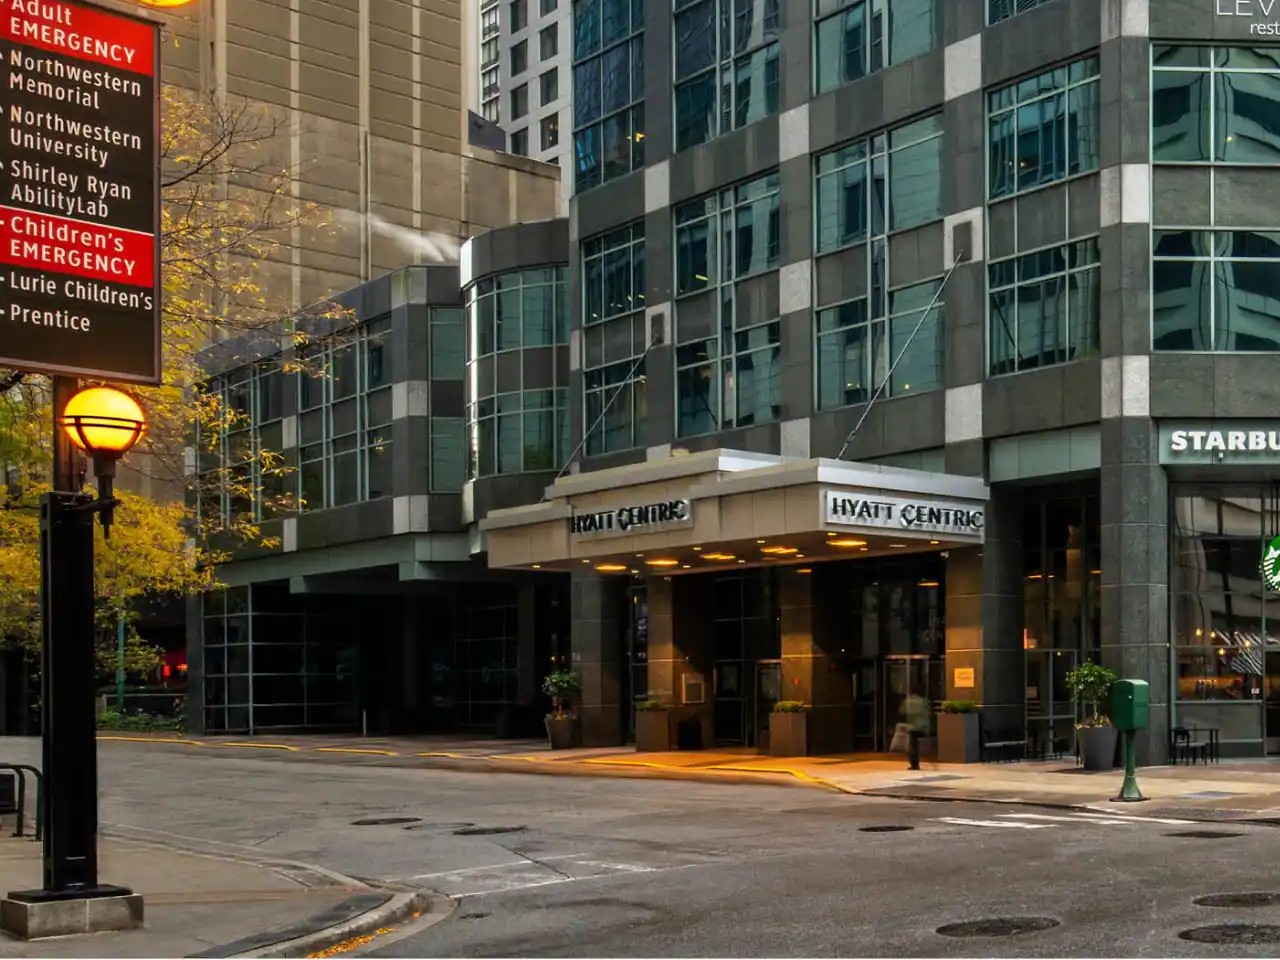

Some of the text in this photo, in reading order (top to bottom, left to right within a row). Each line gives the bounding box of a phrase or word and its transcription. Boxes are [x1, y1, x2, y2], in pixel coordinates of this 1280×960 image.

[10, 16, 136, 64] EMERGENCY
[9, 71, 100, 110] Memorial
[10, 49, 141, 97] Northwestern
[10, 104, 142, 150] Northwestern
[10, 127, 109, 168] University
[10, 159, 131, 200] Shirley Ryan
[11, 183, 109, 218] AbilityLab
[10, 215, 125, 252] Children's
[10, 239, 136, 276] EMERGENCY
[10, 271, 153, 310] Lurie Children's
[10, 303, 91, 332] Prentice
[570, 500, 687, 534] HYATT CENTRIC
[832, 497, 984, 528] HYATT CENTRIC
